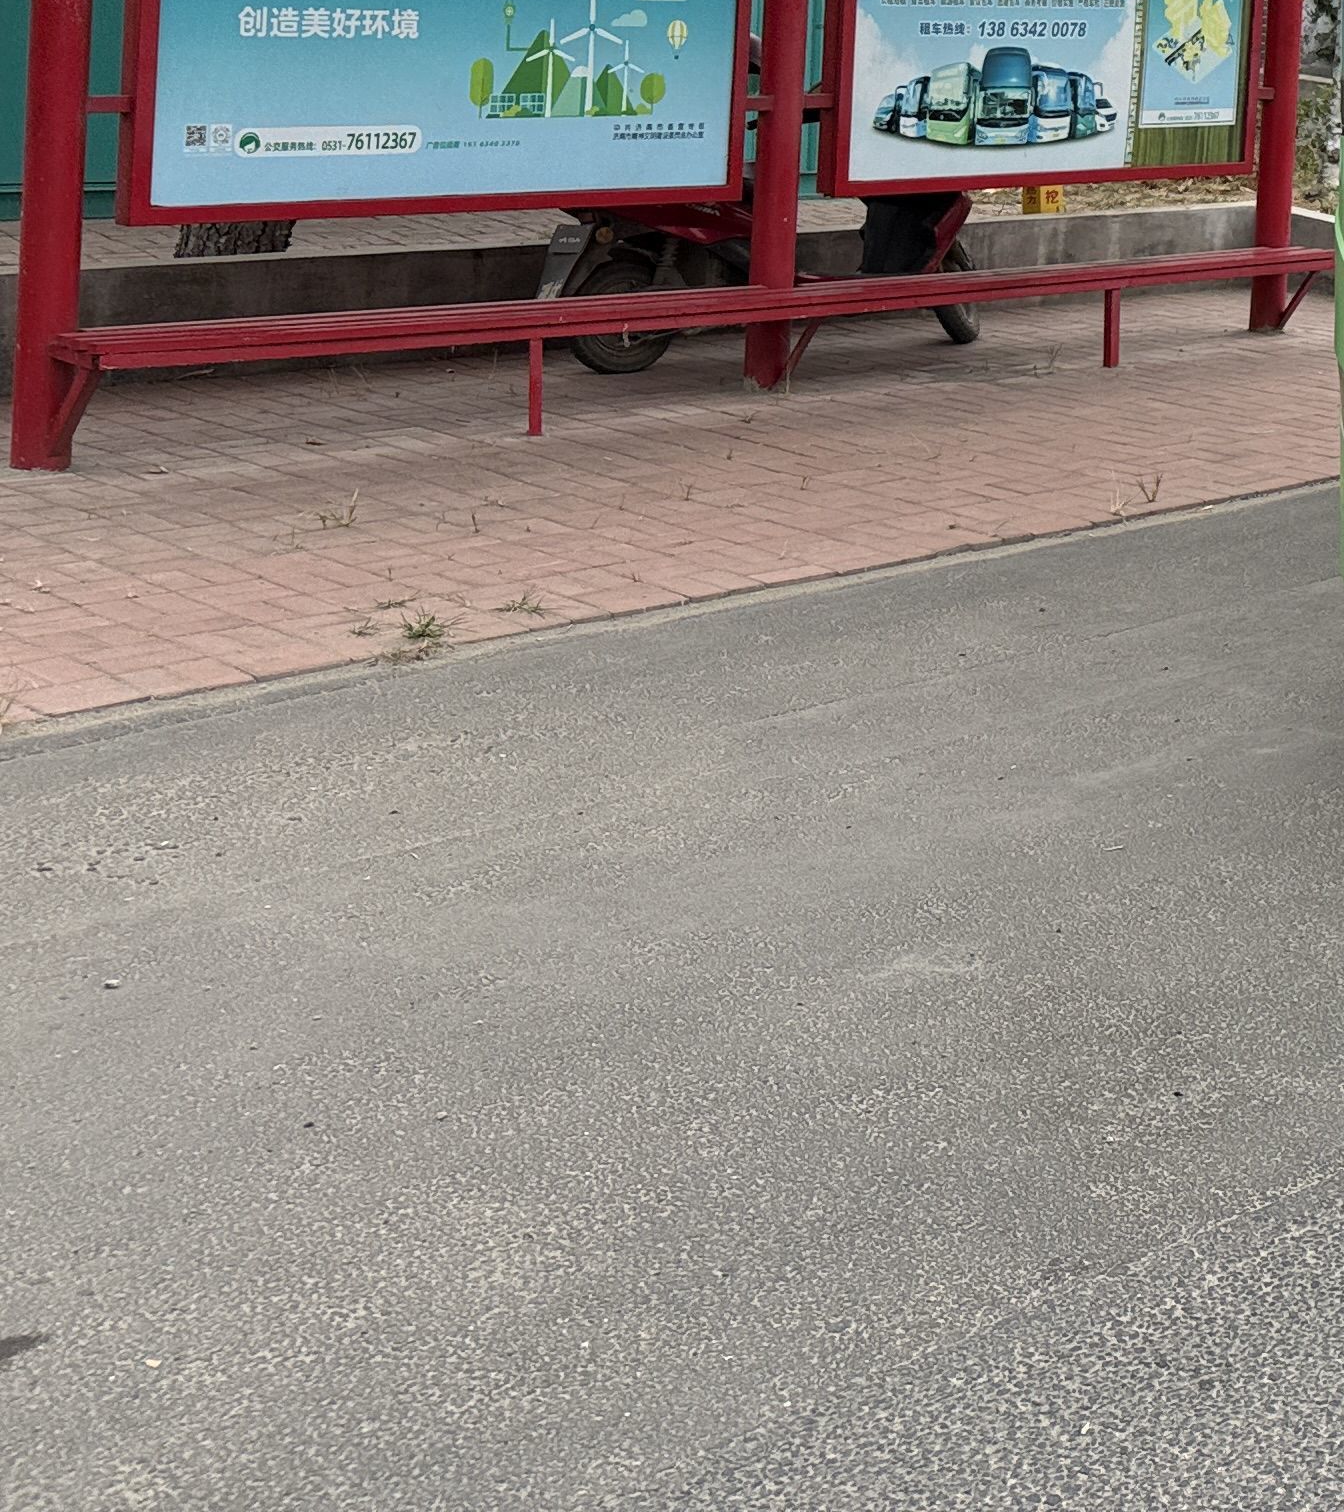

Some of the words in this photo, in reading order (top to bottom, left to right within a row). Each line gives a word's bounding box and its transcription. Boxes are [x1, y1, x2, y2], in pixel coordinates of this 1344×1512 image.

[237, 6, 420, 41] 创造美好环境
[978, 21, 1006, 37] 138
[1010, 21, 1047, 37] 6342
[1051, 21, 1087, 37] 0078
